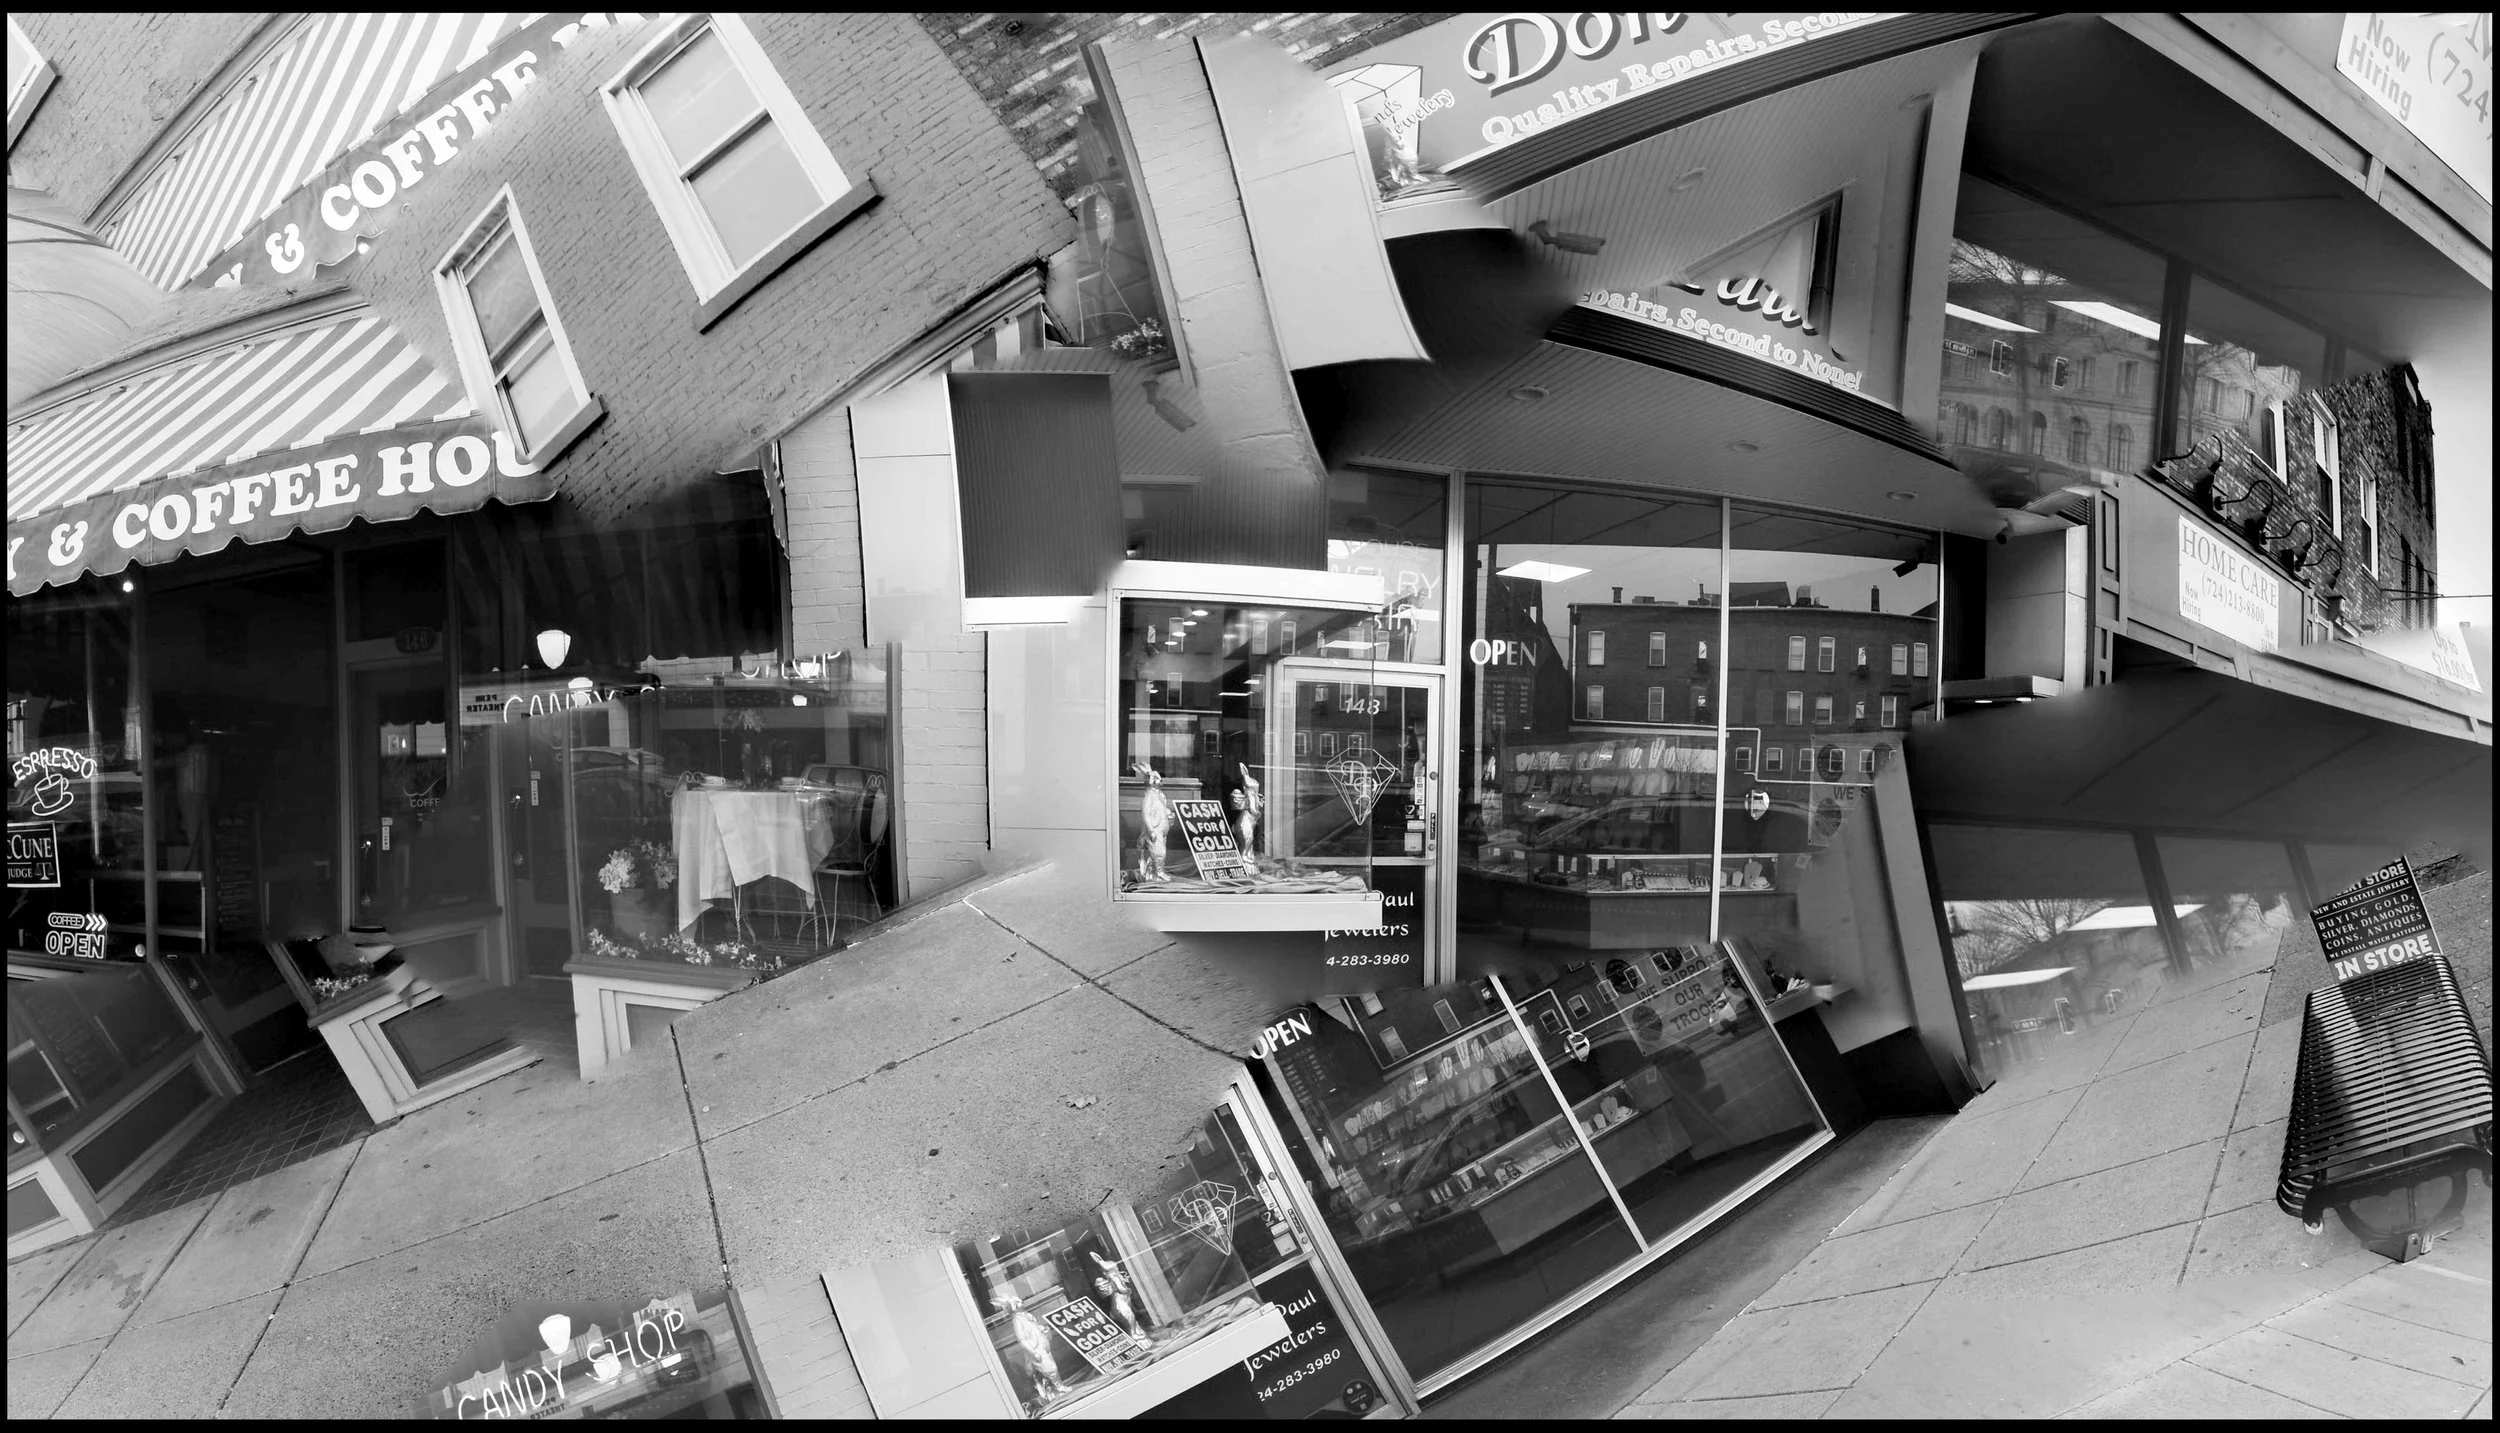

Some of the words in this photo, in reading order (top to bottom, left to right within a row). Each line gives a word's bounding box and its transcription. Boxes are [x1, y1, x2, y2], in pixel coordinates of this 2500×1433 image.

[2366, 13, 2411, 73] Now
[1481, 78, 1620, 147] Quality
[1621, 32, 1767, 92] Repairs,
[2348, 34, 2412, 122] Hiring
[265, 223, 305, 274] &
[320, 50, 537, 232] COFFEE
[1677, 307, 1771, 357] Second
[1774, 342, 1797, 365] to
[1800, 349, 1864, 391] None!
[48, 521, 88, 567] &
[113, 454, 360, 549] COFFEE
[2182, 525, 2237, 583] HOME
[2240, 564, 2277, 608] CARE
[1470, 638, 1537, 667] OPEN
[1344, 698, 1381, 715] 148
[1180, 803, 1221, 819] CASH
[1197, 822, 1220, 833] FOR
[1192, 836, 1233, 852] GOLD
[2365, 862, 2406, 886] STORE
[2312, 905, 2329, 916] NEW
[2332, 898, 2348, 910] AND
[2350, 888, 2376, 903] ESTATE
[2377, 877, 2410, 895] JEWELRY
[2318, 907, 2368, 931] BUYING
[2366, 912, 2423, 937] ANTIQUES
[46, 930, 105, 960] OPEN
[2334, 957, 2361, 980] IN
[2363, 933, 2432, 971] STORE
[2341, 943, 2367, 956] INSTALL
[2368, 935, 2391, 946] WATCH
[1674, 982, 1704, 1006] OUR
[1051, 1300, 1094, 1326] CASH
[1075, 1317, 1099, 1333] FOR
[1076, 1324, 1119, 1350] GOLD
[1243, 1321, 1327, 1382] Jewelers
[457, 1360, 565, 1420] CANDY
[586, 1311, 684, 1382] SHOP
